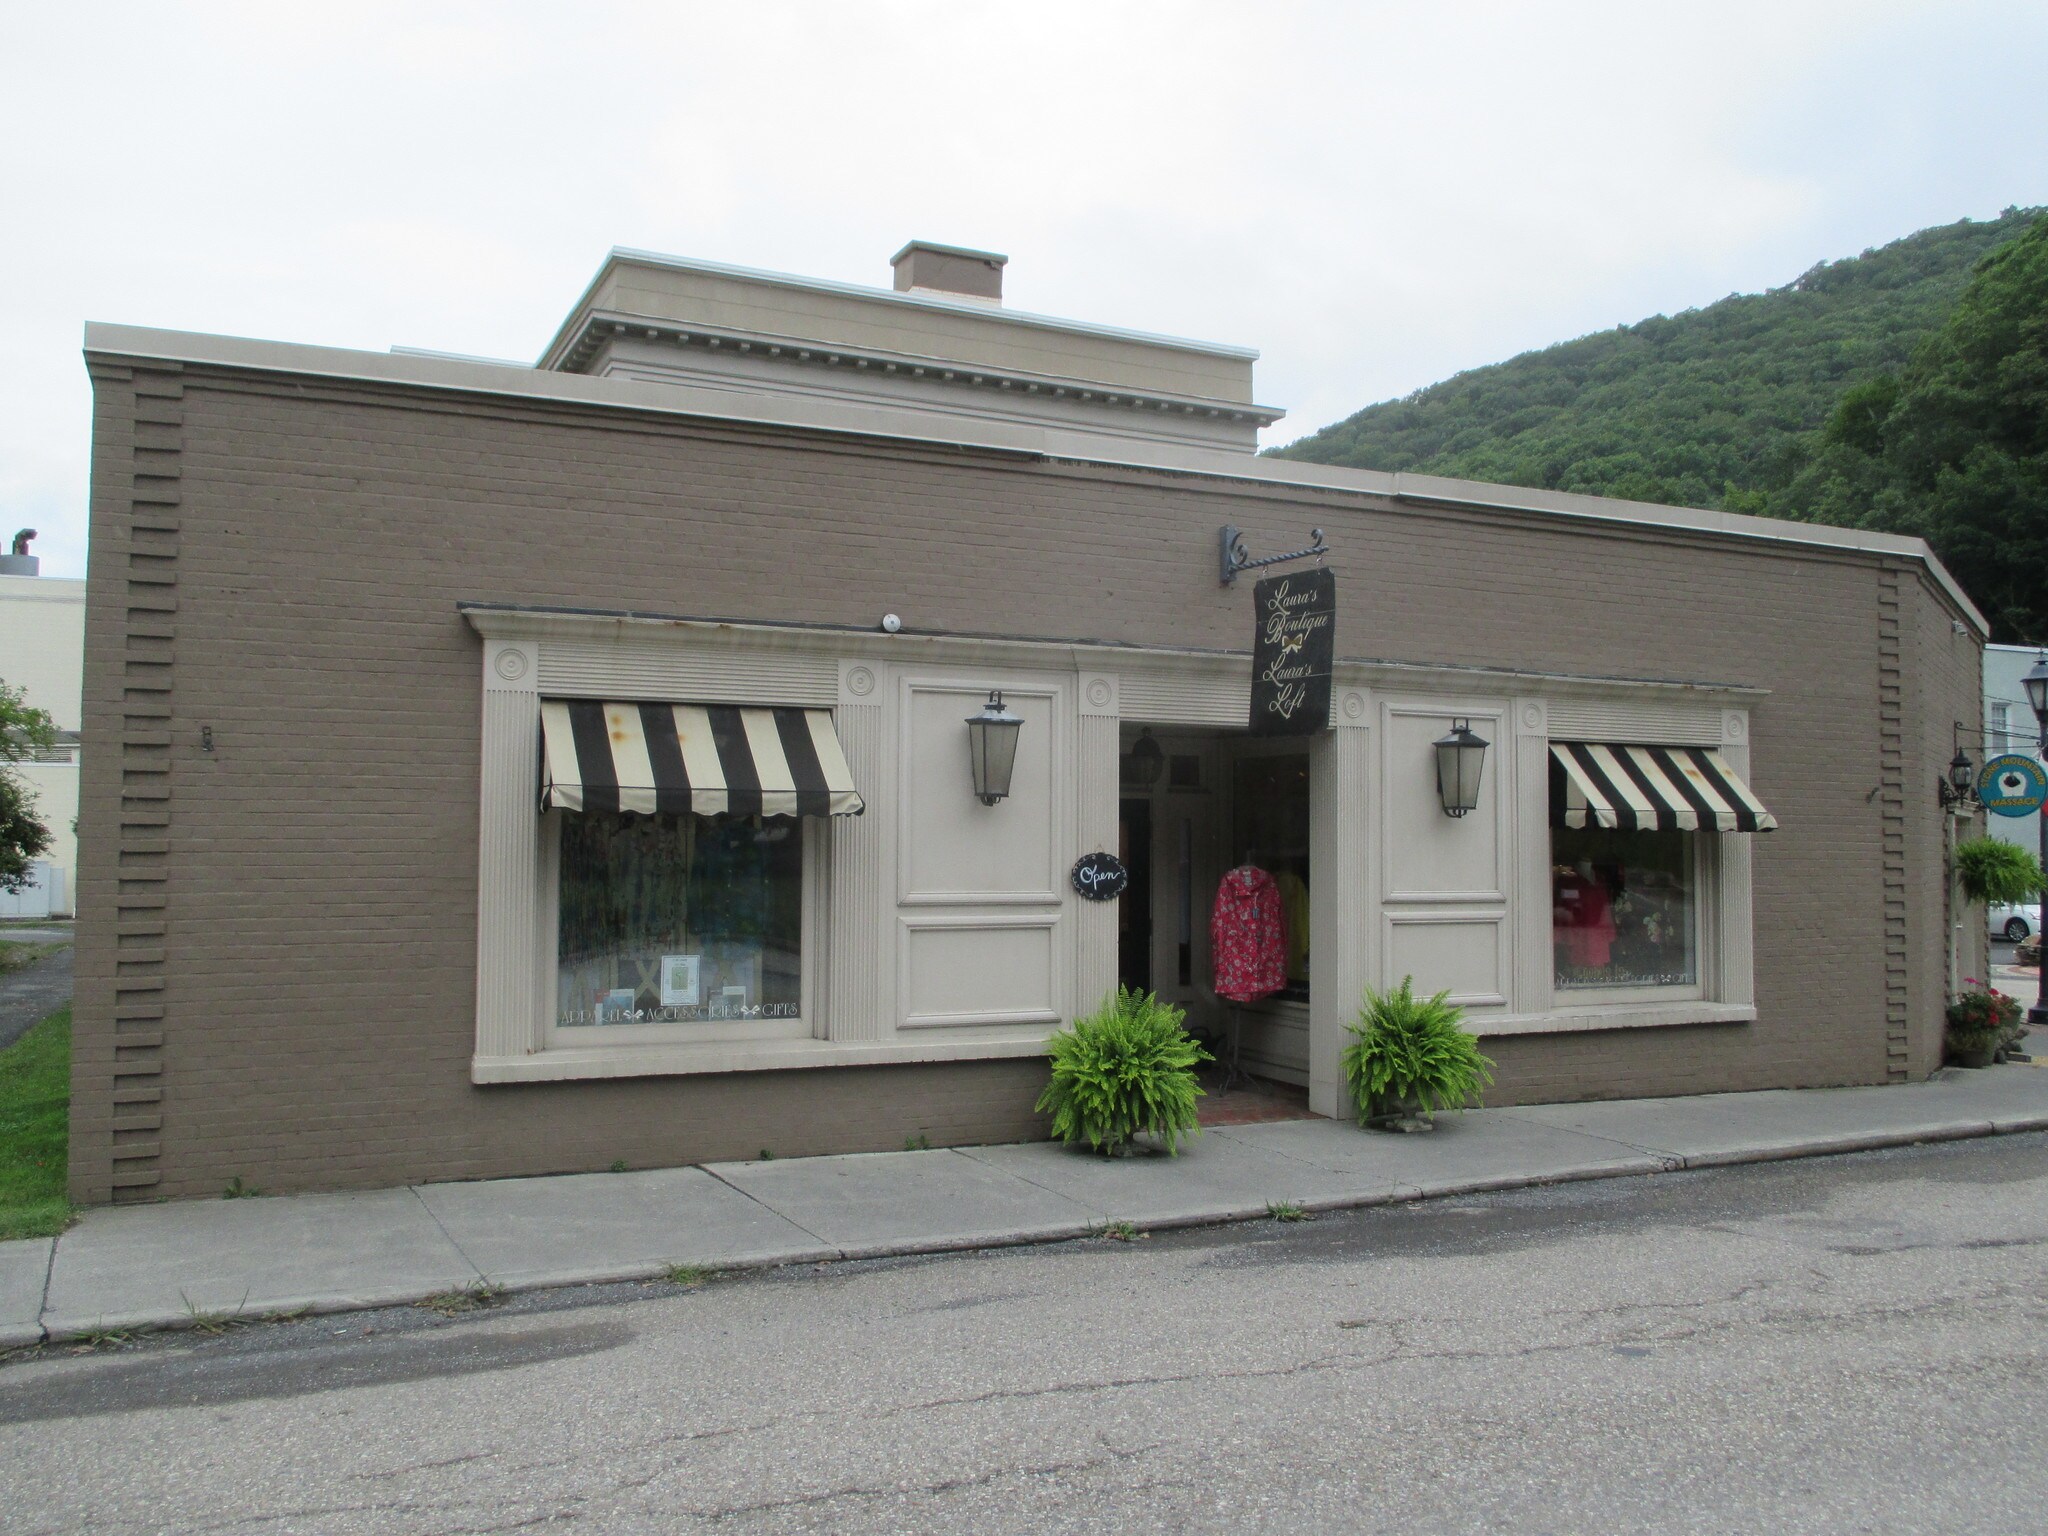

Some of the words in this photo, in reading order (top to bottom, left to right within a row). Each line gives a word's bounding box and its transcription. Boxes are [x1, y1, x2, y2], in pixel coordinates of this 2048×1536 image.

[1268, 580, 1318, 615] Laura's
[1265, 611, 1328, 644] Boutique
[1263, 653, 1312, 687] Laura's
[1269, 683, 1306, 720] Loft
[2000, 757, 2045, 785] MOUNTAIN
[1990, 797, 2038, 806] MASSAGE
[1080, 864, 1121, 891] Open
[646, 1004, 740, 1022] ACCESSORIES
[762, 1002, 798, 1017] GIFTS
